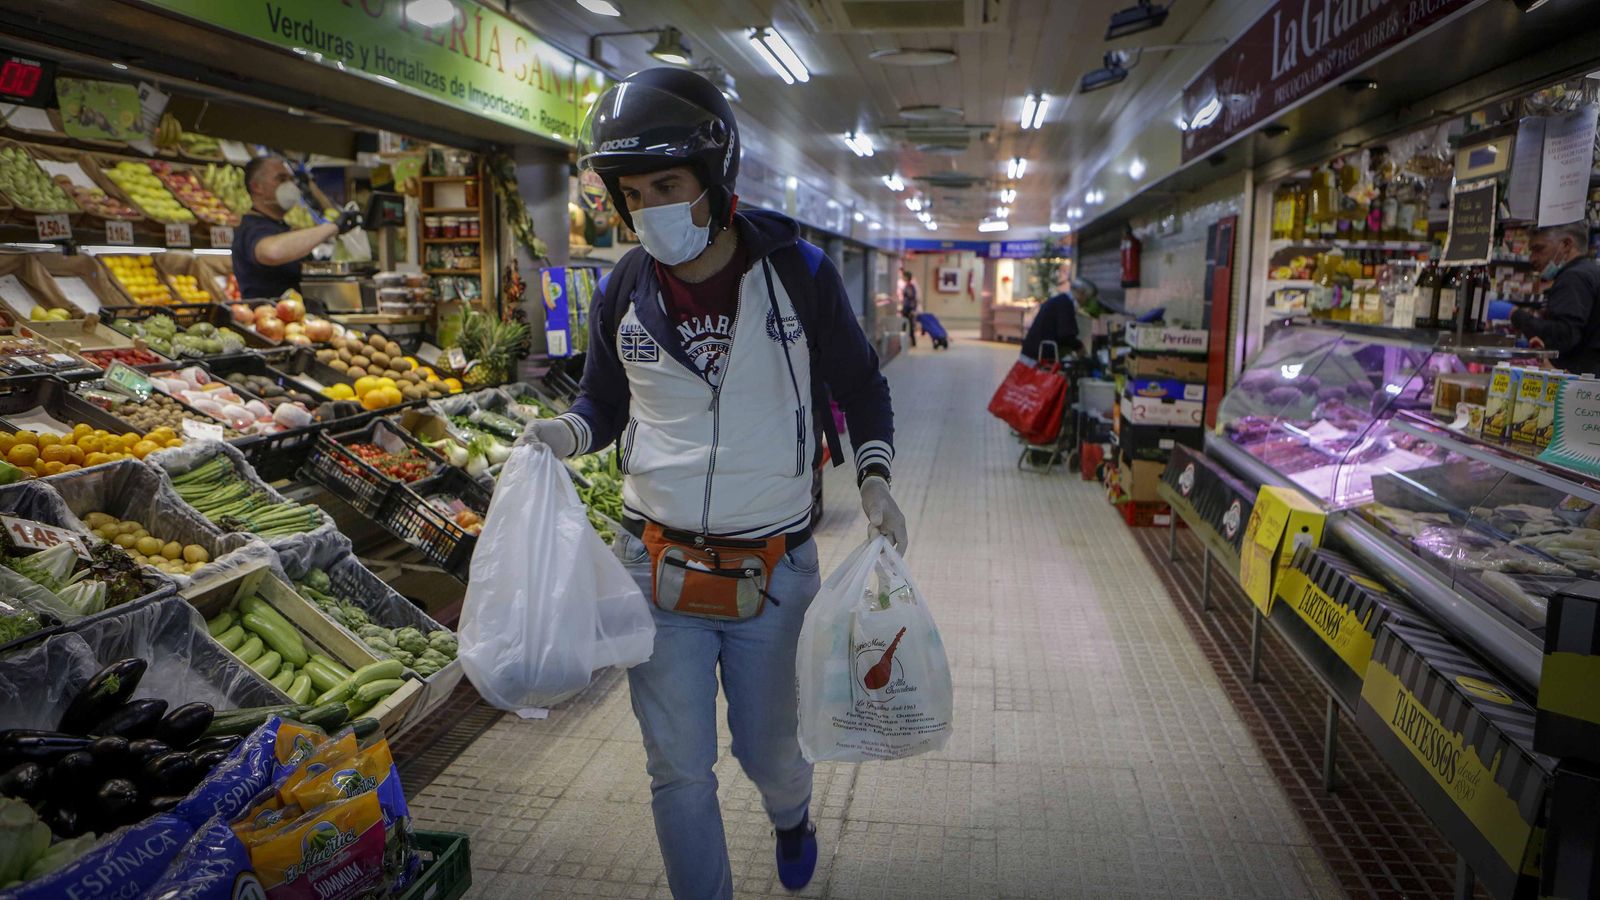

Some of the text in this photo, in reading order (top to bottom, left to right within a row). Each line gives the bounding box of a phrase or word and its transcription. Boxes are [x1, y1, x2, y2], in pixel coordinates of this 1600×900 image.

[1409, 0, 1450, 24] BAC
[266, 3, 354, 60] Verduras
[360, 44, 370, 71] y
[375, 45, 447, 92] Hortalizas
[450, 76, 465, 98] de
[468, 81, 530, 121] Importación
[1271, 10, 1298, 81] La
[676, 314, 735, 347] NZAR
[1298, 583, 1345, 640] TARTESSOS
[1392, 690, 1481, 788] TARTESSOS desde
[1454, 780, 1476, 801] 1890
[65, 828, 179, 900] ESPINACA
[314, 861, 365, 900] SUMMUM
